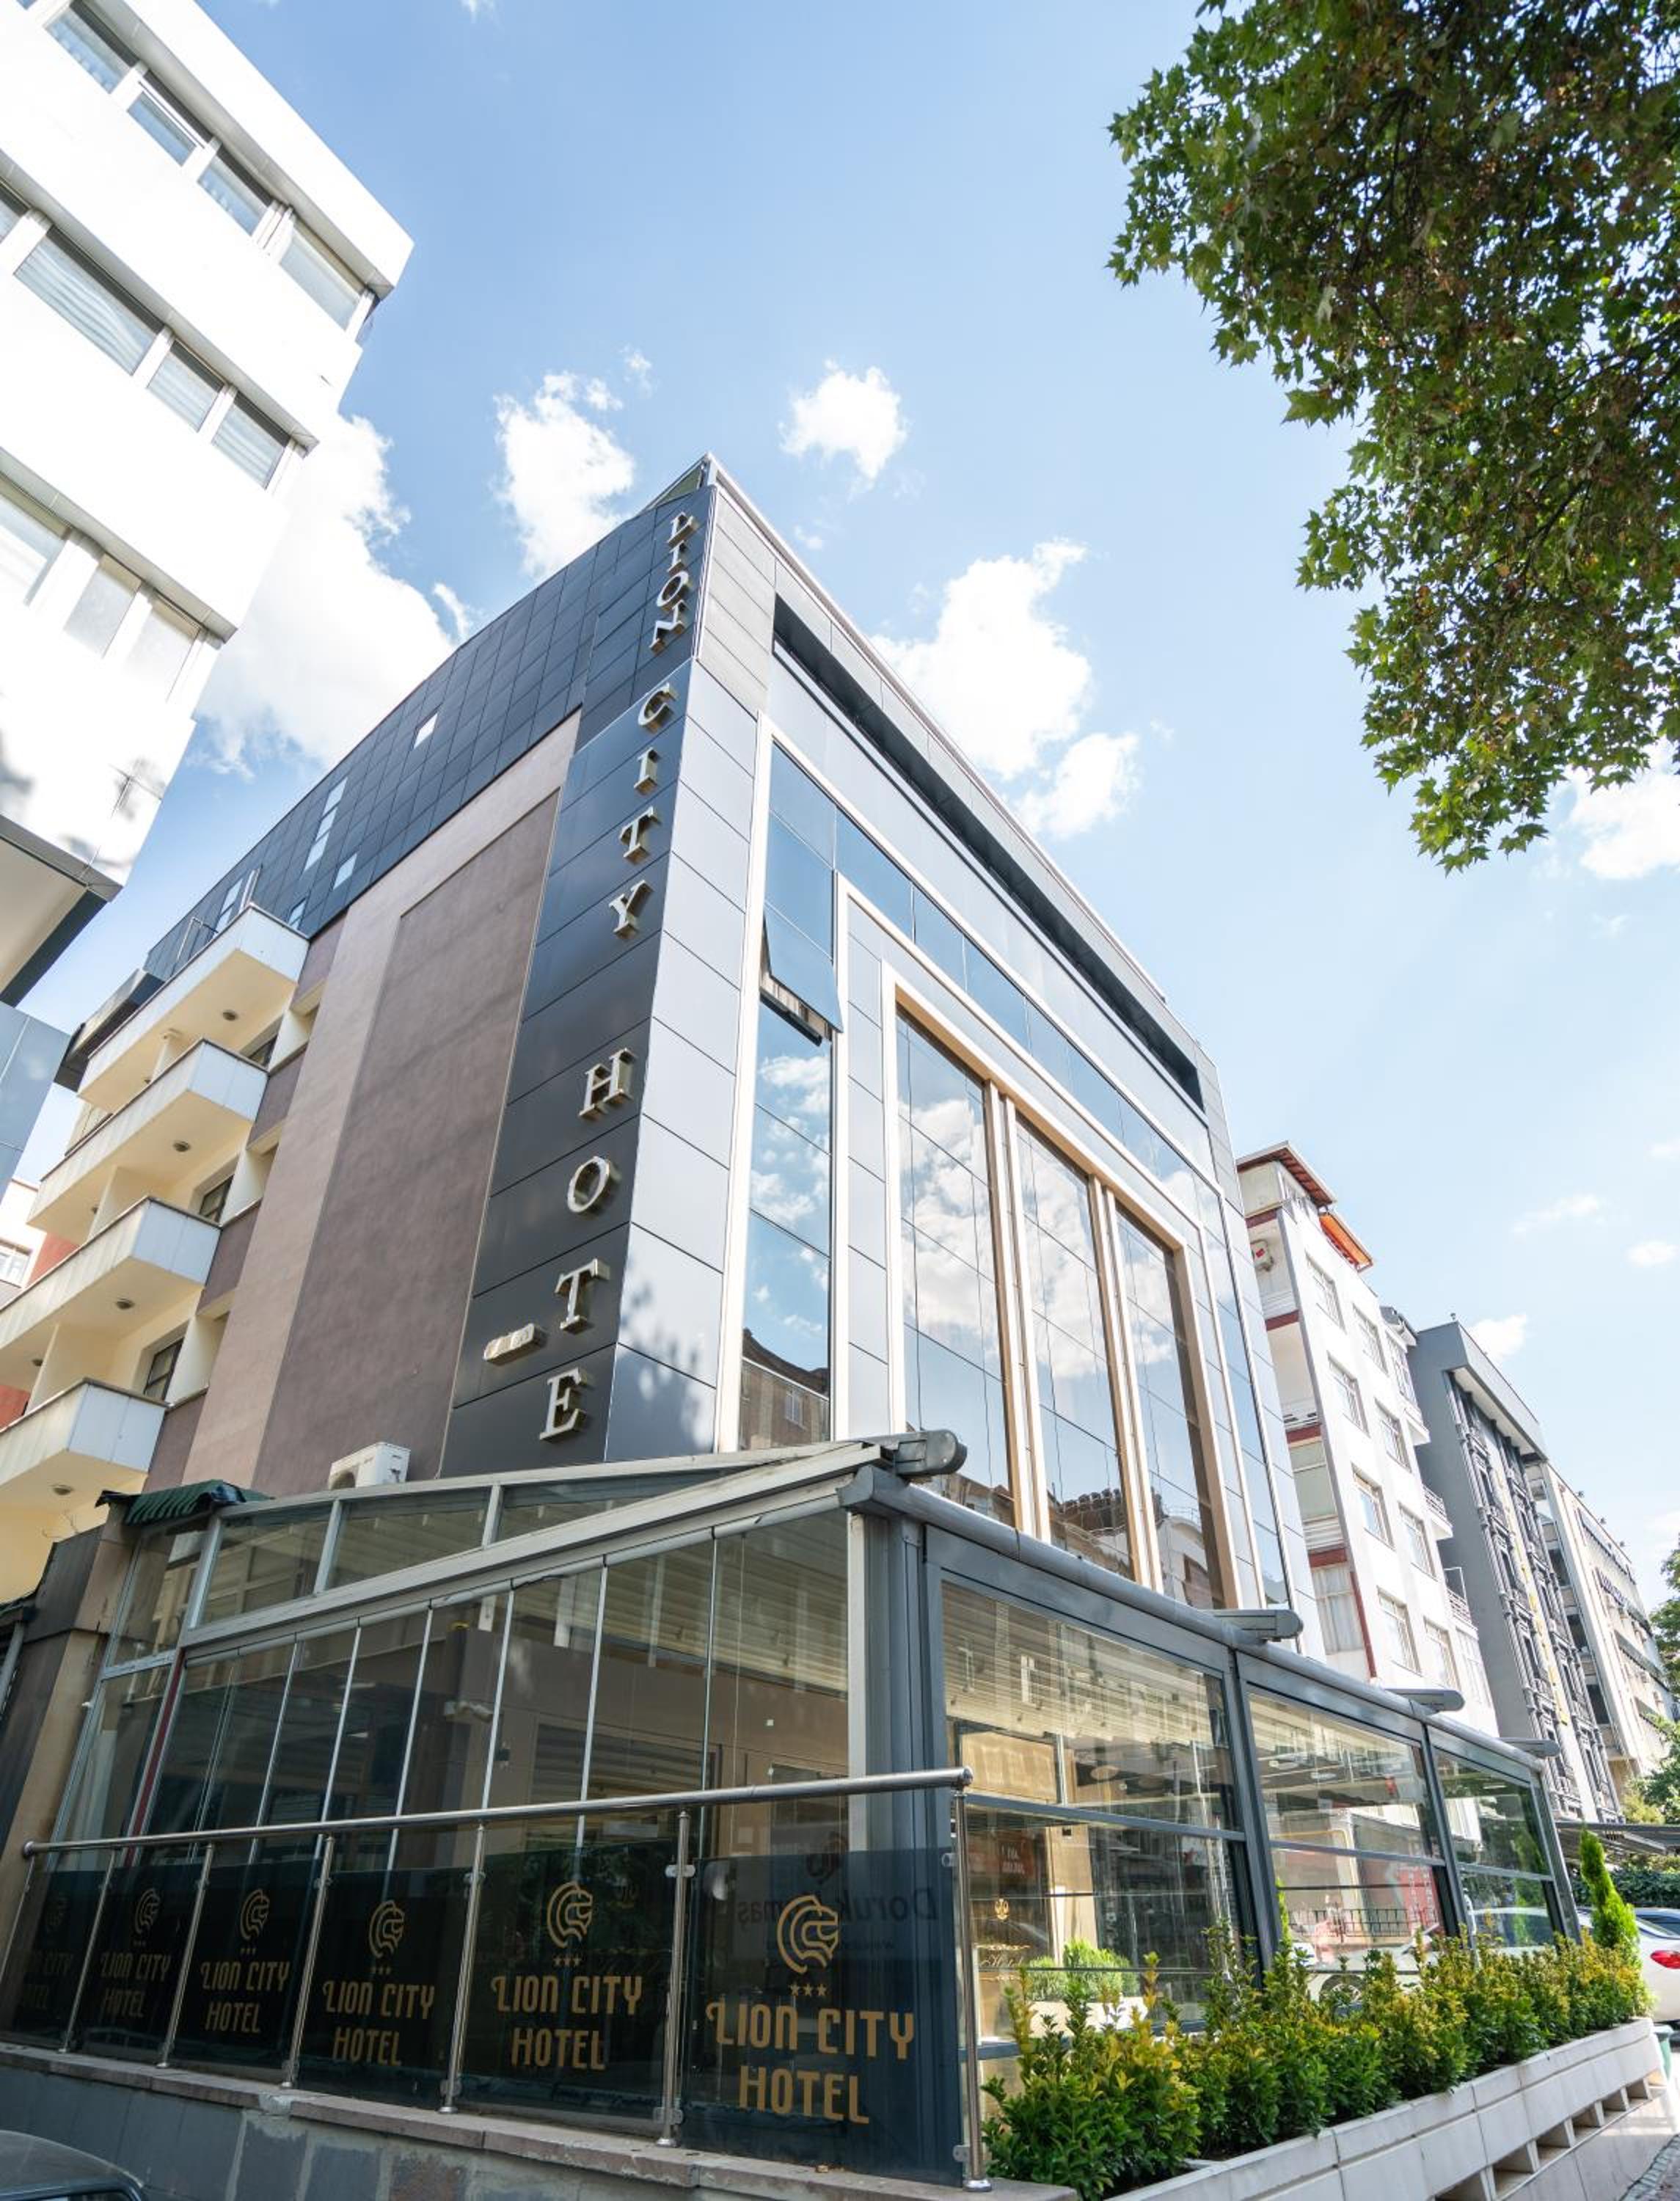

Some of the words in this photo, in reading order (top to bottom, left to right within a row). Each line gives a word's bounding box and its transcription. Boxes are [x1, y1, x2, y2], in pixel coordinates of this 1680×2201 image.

[649, 511, 698, 653] LION
[610, 683, 677, 940] CITY
[135, 1953, 172, 1982] CITY
[200, 1961, 241, 1990] LION
[246, 1961, 291, 1992] CITY
[101, 1988, 146, 2018] HOTEL
[322, 1981, 373, 2015] LION
[380, 1983, 436, 2020] CITY
[492, 1974, 558, 2014] LION
[571, 1975, 642, 2015] CITY
[205, 2002, 261, 2034] HOTEL
[705, 1999, 799, 2051] LION
[817, 2007, 916, 2059] CITY
[332, 2026, 401, 2067] HOTEL
[511, 2028, 607, 2070] HOTEL
[738, 2065, 870, 2125] HOTEL
